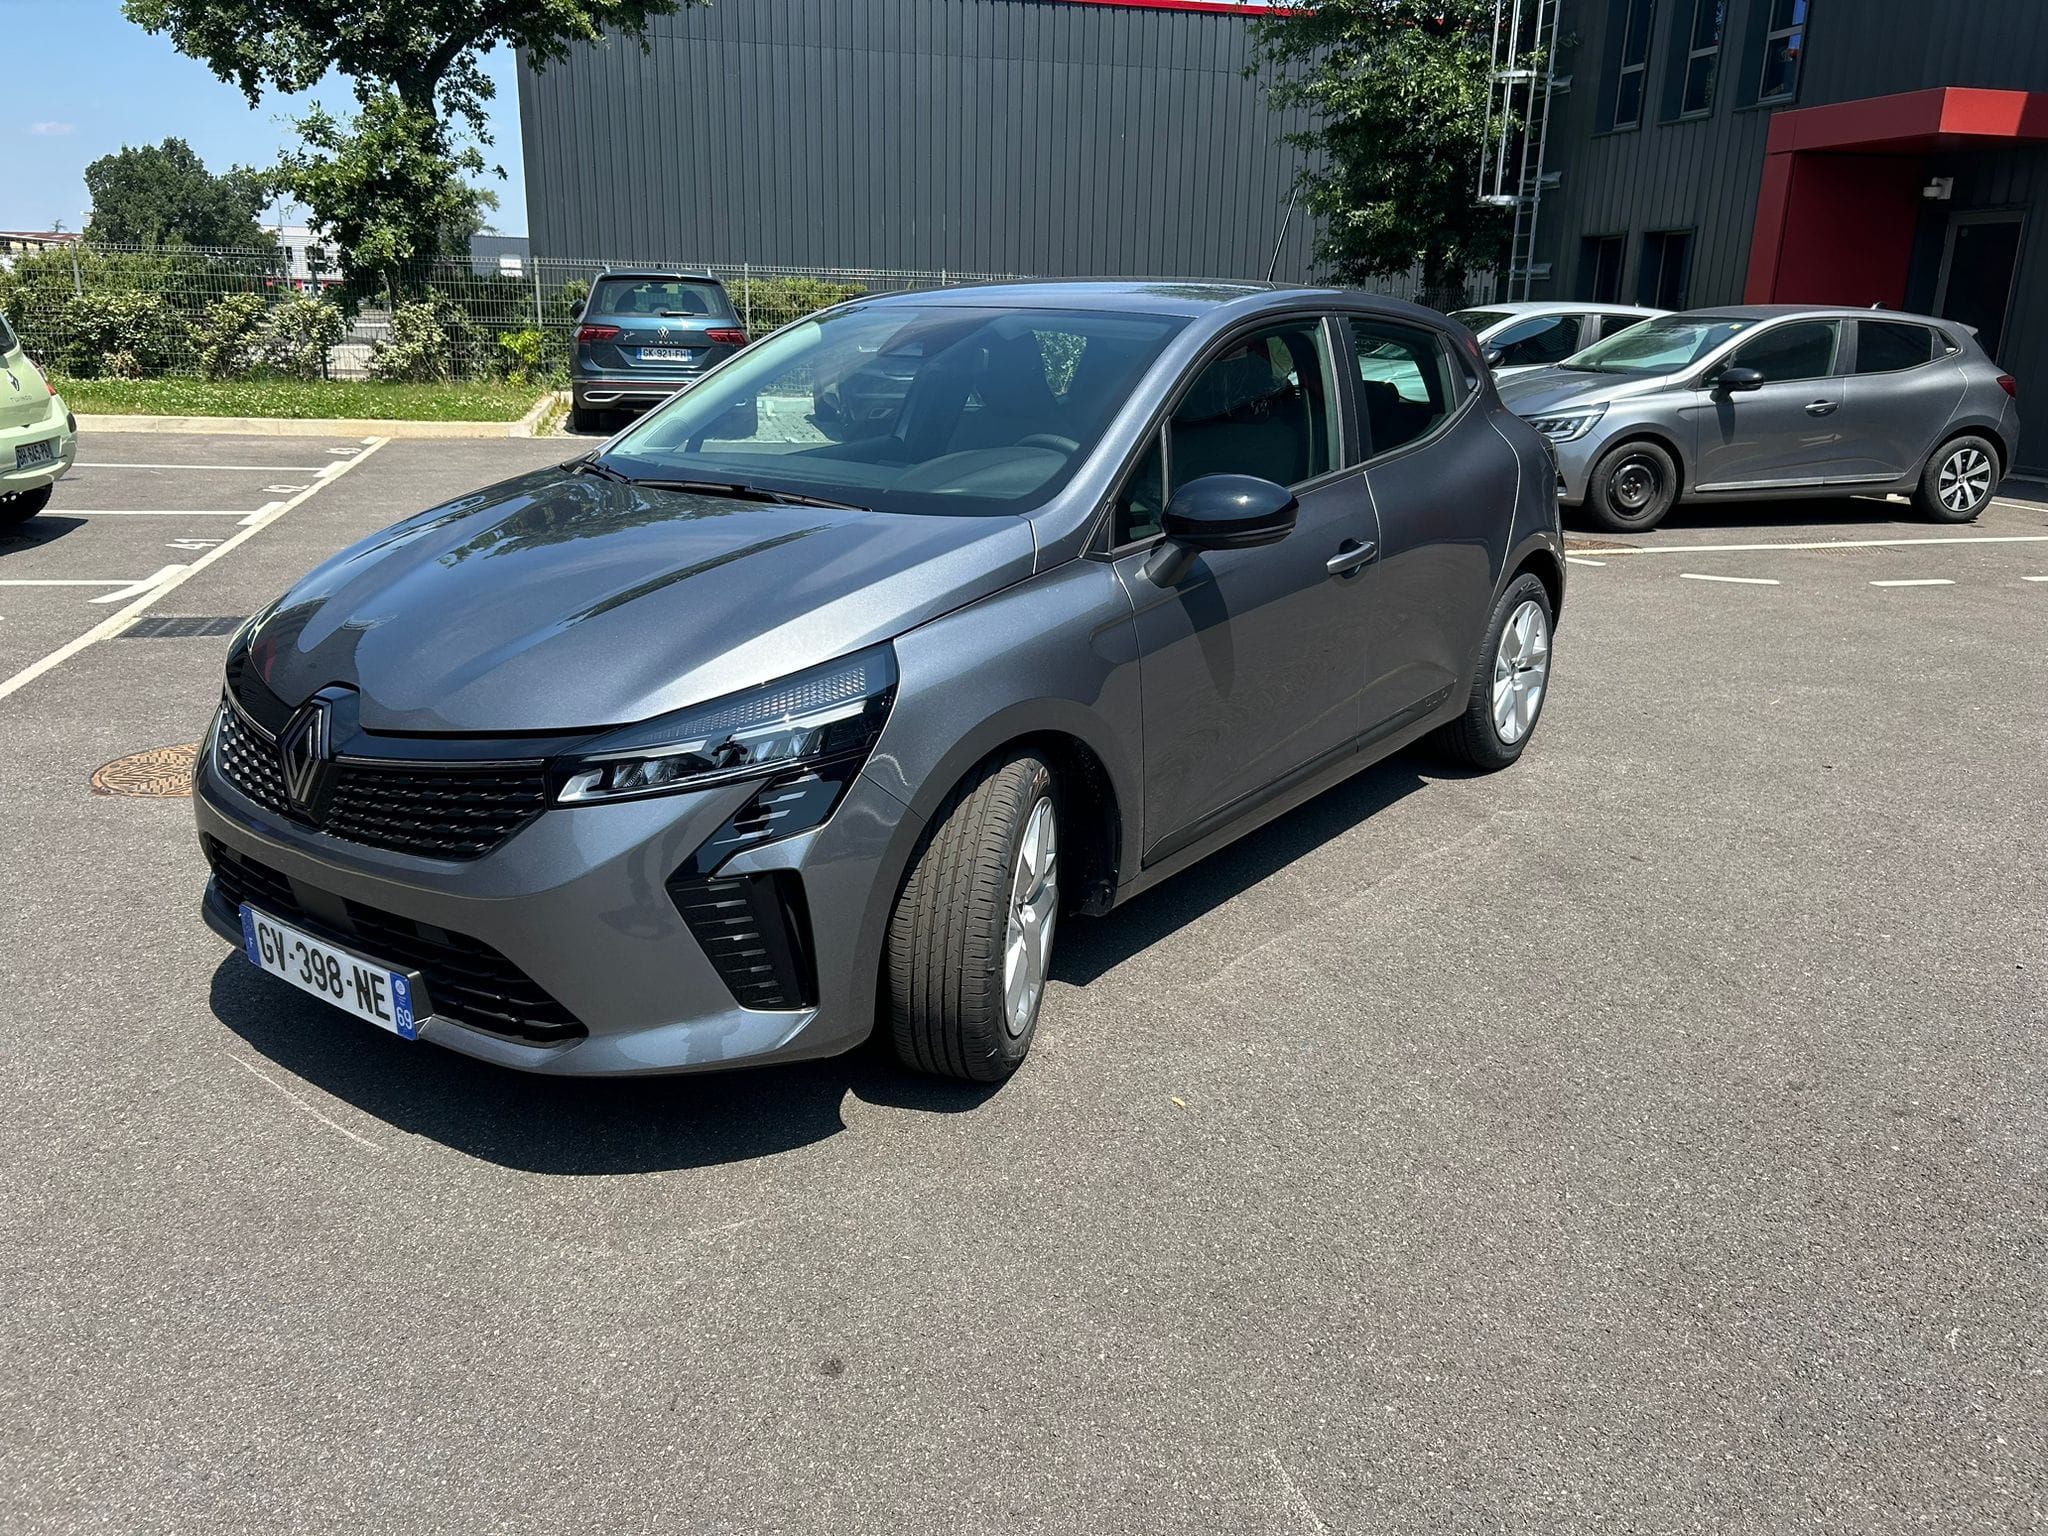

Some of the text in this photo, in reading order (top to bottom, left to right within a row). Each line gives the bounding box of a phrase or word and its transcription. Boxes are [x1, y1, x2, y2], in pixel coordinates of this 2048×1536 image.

[642, 348, 686, 358] GK-921-FH
[262, 484, 310, 493] 42
[165, 538, 225, 550] 41
[1424, 689, 1449, 707] CLO
[258, 922, 391, 1022] GV-398-NE
[396, 1006, 413, 1030] 69
